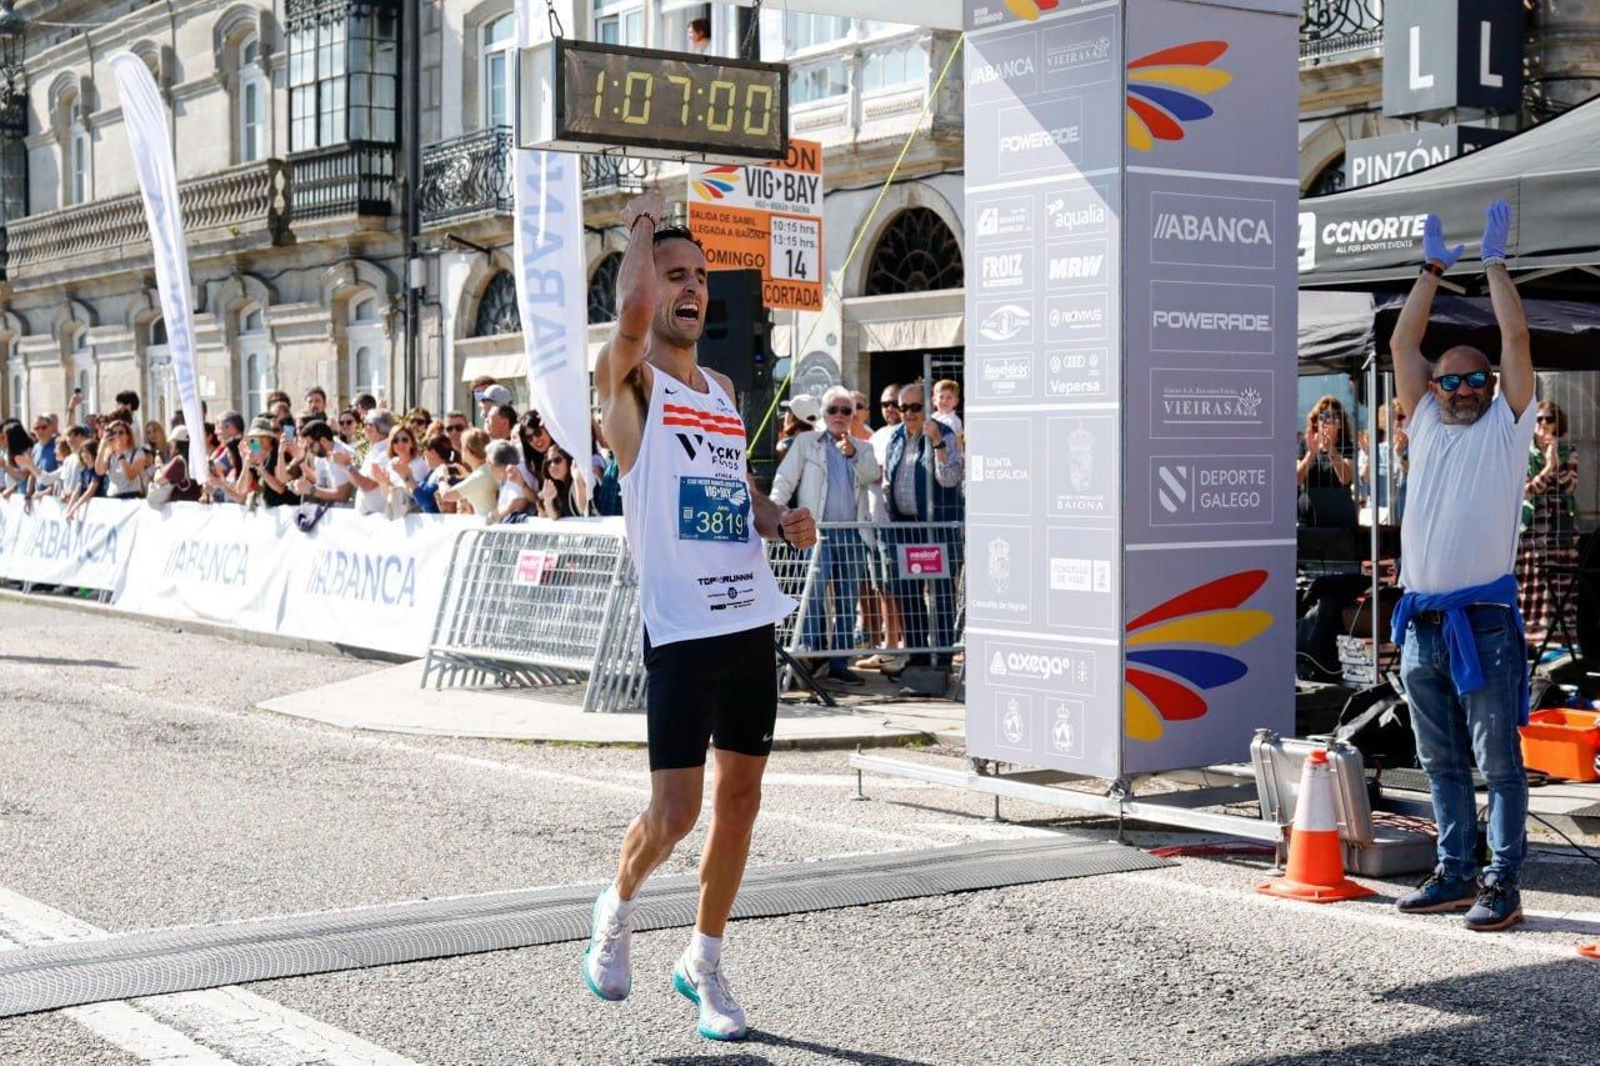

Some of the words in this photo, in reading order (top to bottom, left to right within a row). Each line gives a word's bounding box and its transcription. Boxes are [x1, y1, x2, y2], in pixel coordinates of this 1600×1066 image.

[1409, 26, 1434, 90] L
[1480, 20, 1503, 87] L
[593, 70, 772, 136] 1:07:00
[1000, 126, 1081, 153] POWERADE
[719, 213, 730, 223] DE
[773, 220, 798, 232] 10:15
[1056, 204, 1104, 230] aqualia
[773, 234, 798, 247] 13:15
[1322, 213, 1429, 245] CCNORTE
[706, 248, 766, 268] OMINGO
[1335, 245, 1347, 254] ALL
[1348, 244, 1361, 253] FOR
[1362, 242, 1386, 251] SPORTS
[1388, 240, 1413, 250] EVENTS
[785, 250, 807, 279] 14
[982, 253, 1023, 279] FROIZ
[1050, 254, 1105, 280] MRW
[764, 284, 821, 307] CORTADA
[1153, 310, 1272, 332] POWERADE
[1050, 379, 1100, 396] Vepersa
[1164, 400, 1243, 416] VIEIRASA
[1200, 469, 1266, 486] DEPORTE
[1200, 491, 1260, 508] GALEGO
[695, 511, 743, 535] 3819
